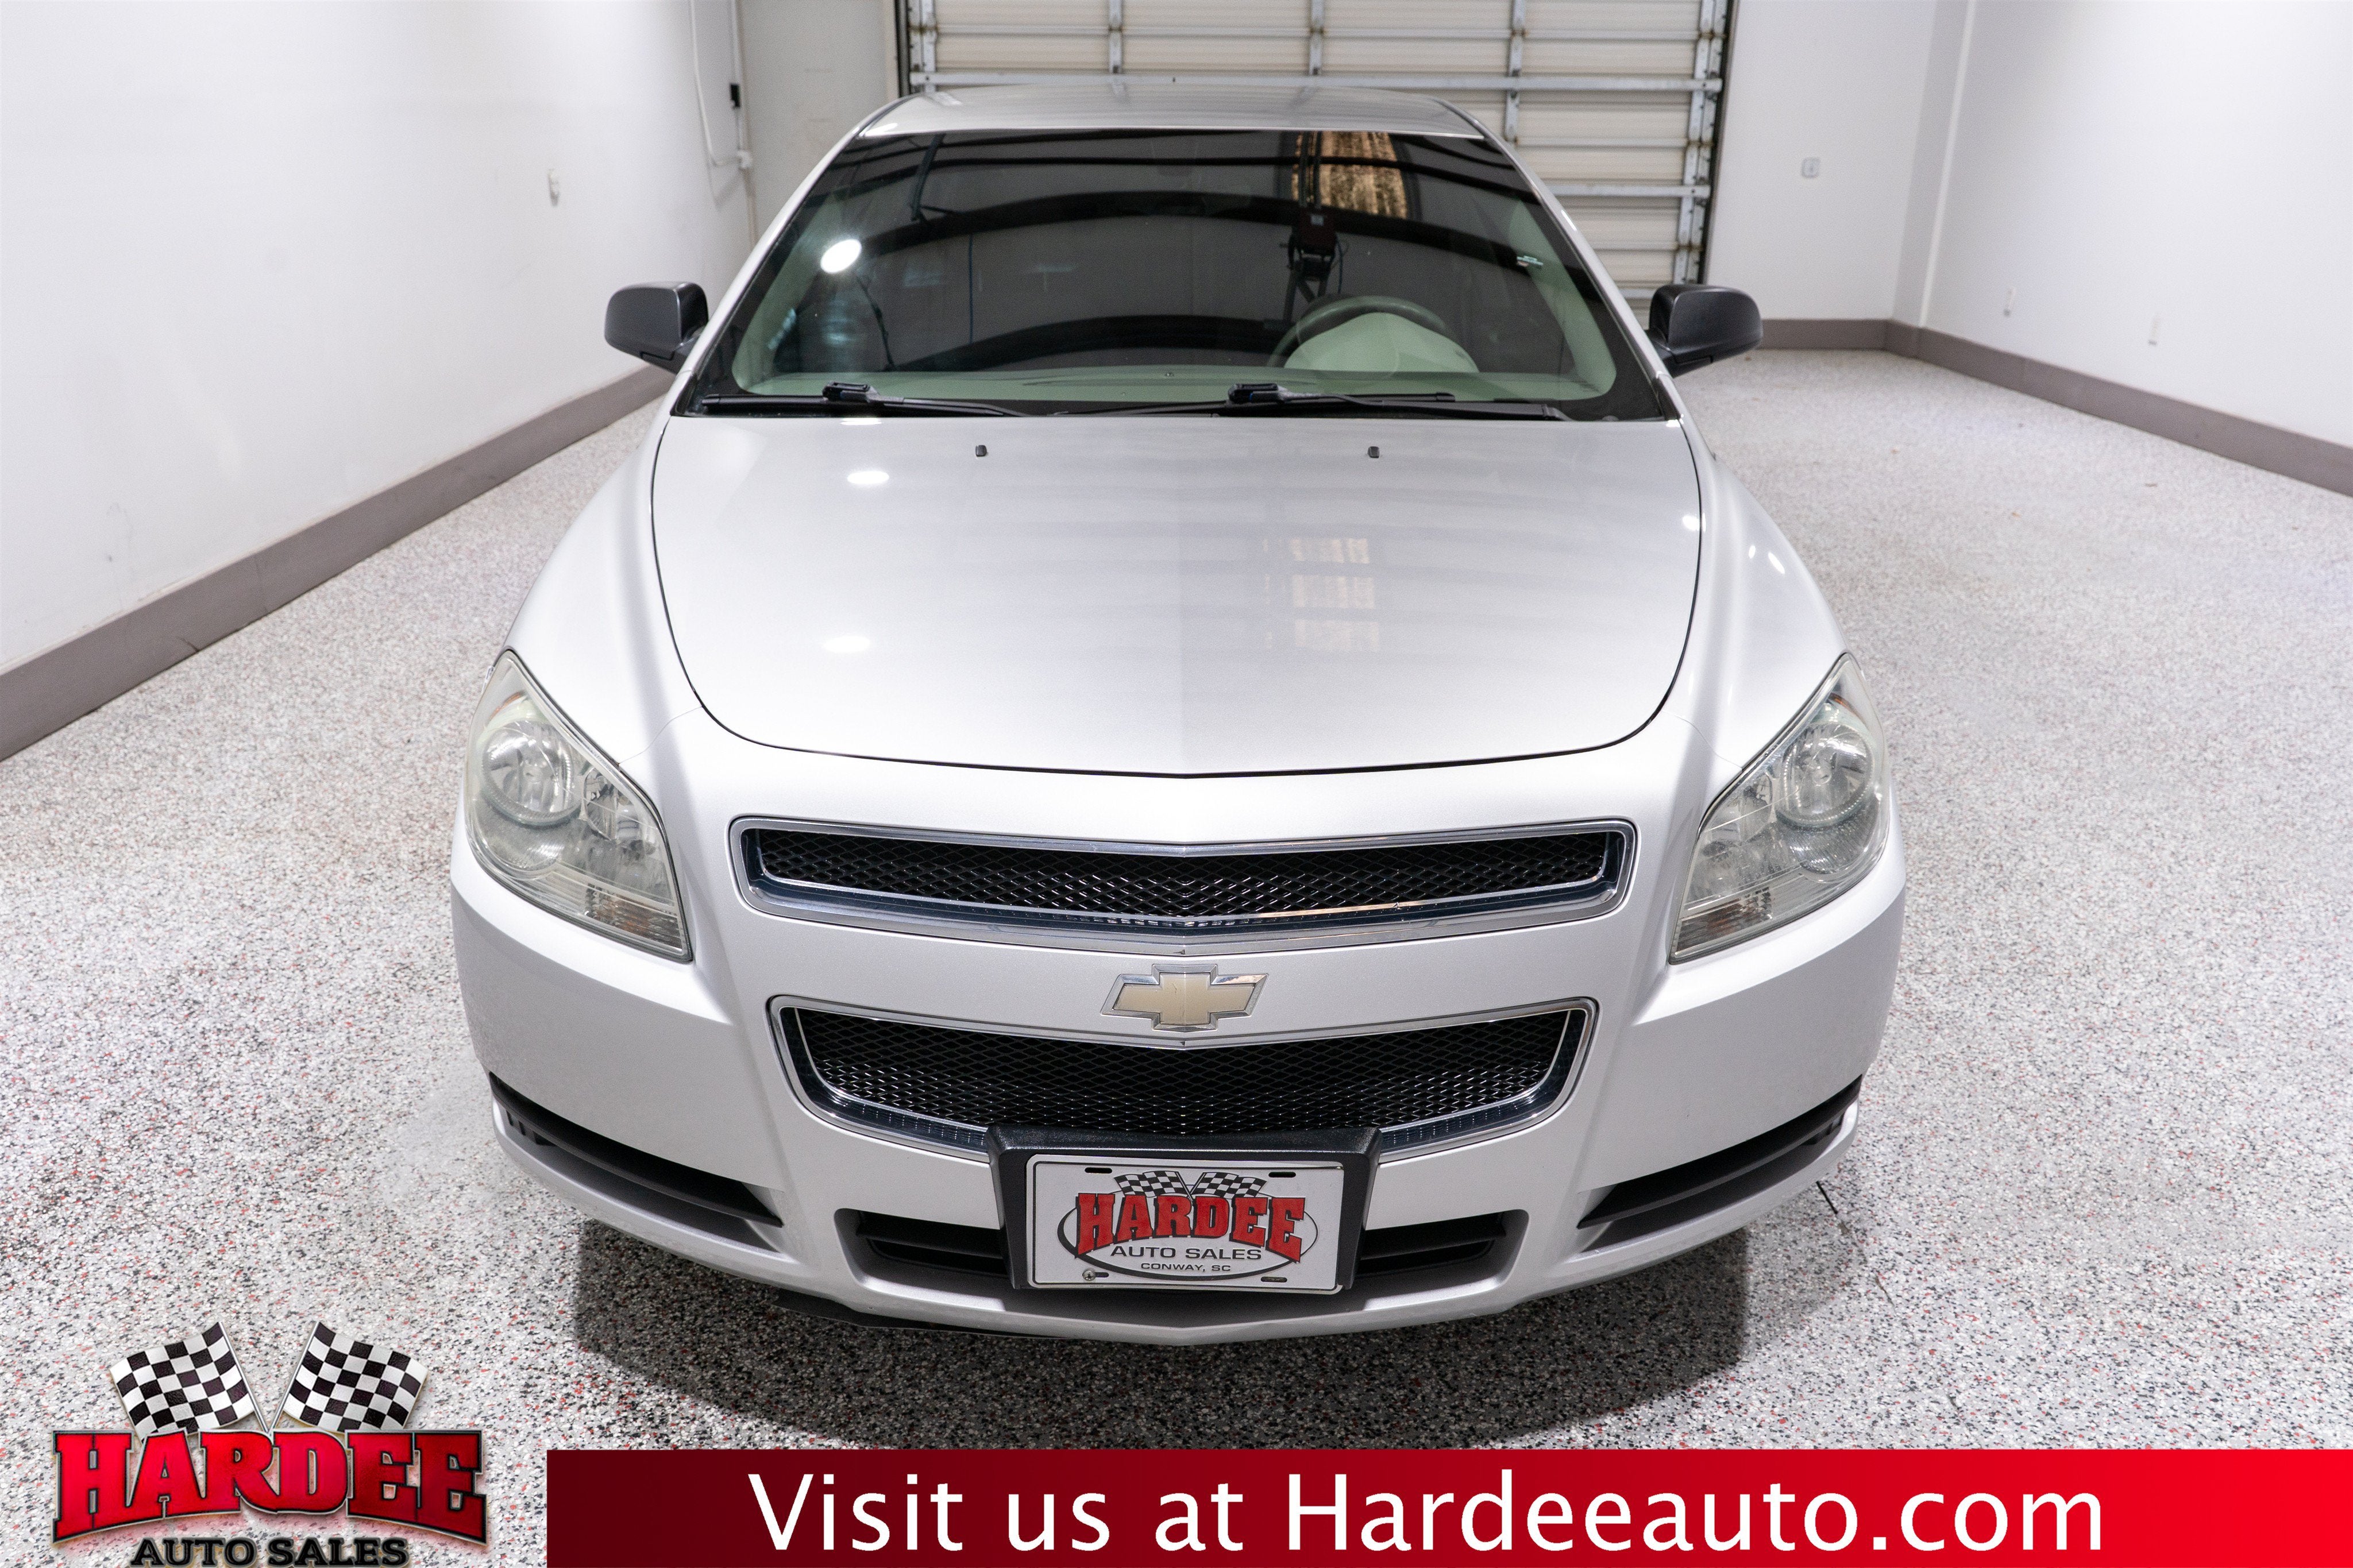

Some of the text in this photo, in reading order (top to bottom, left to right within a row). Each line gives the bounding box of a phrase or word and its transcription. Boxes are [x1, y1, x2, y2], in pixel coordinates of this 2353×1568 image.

[1075, 1193, 1306, 1263] HARDEE
[1110, 1245, 1262, 1260] AUTO SALES
[1140, 1262, 1206, 1272] CONWAY,
